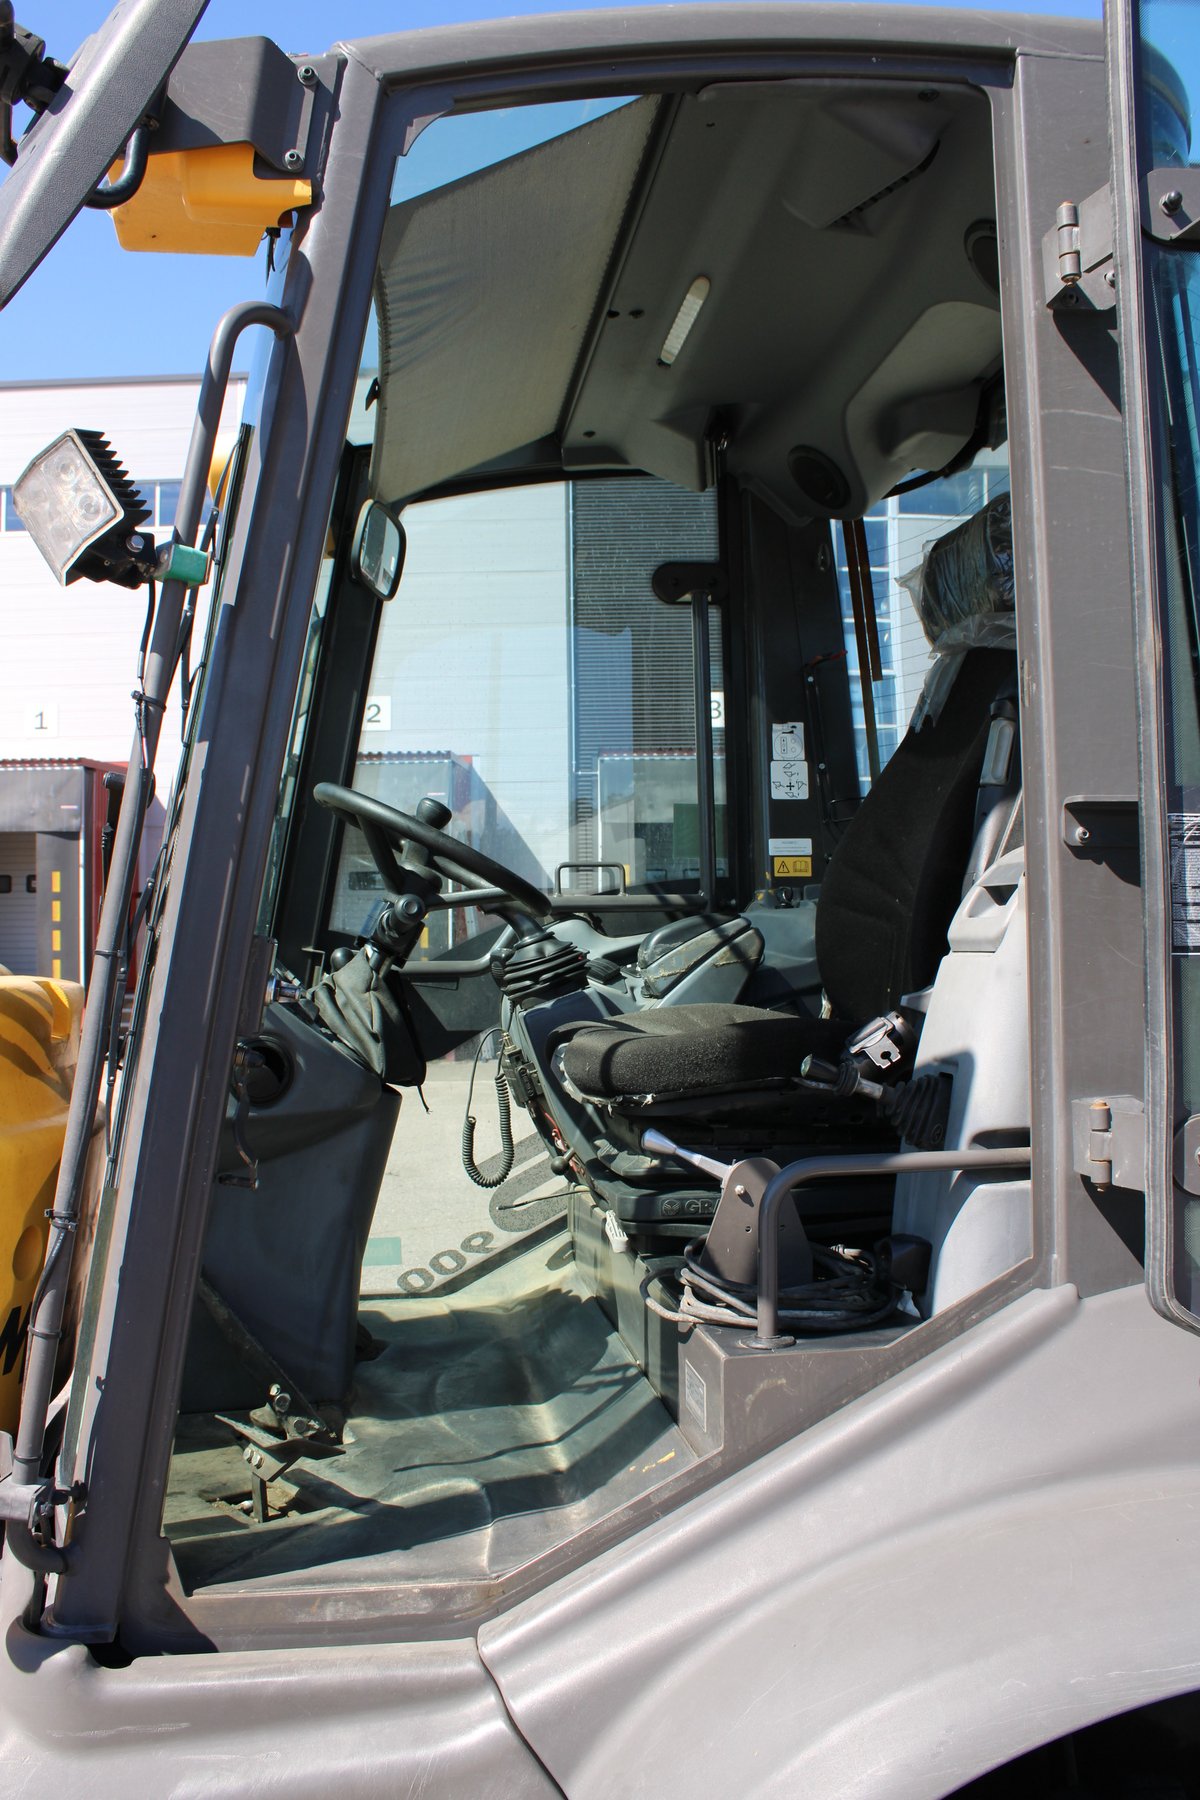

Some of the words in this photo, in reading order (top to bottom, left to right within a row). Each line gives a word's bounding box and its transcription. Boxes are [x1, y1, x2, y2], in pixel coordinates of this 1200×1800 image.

[34, 711, 48, 730] 1
[366, 703, 381, 723] 2
[684, 1198, 721, 1215] GR
